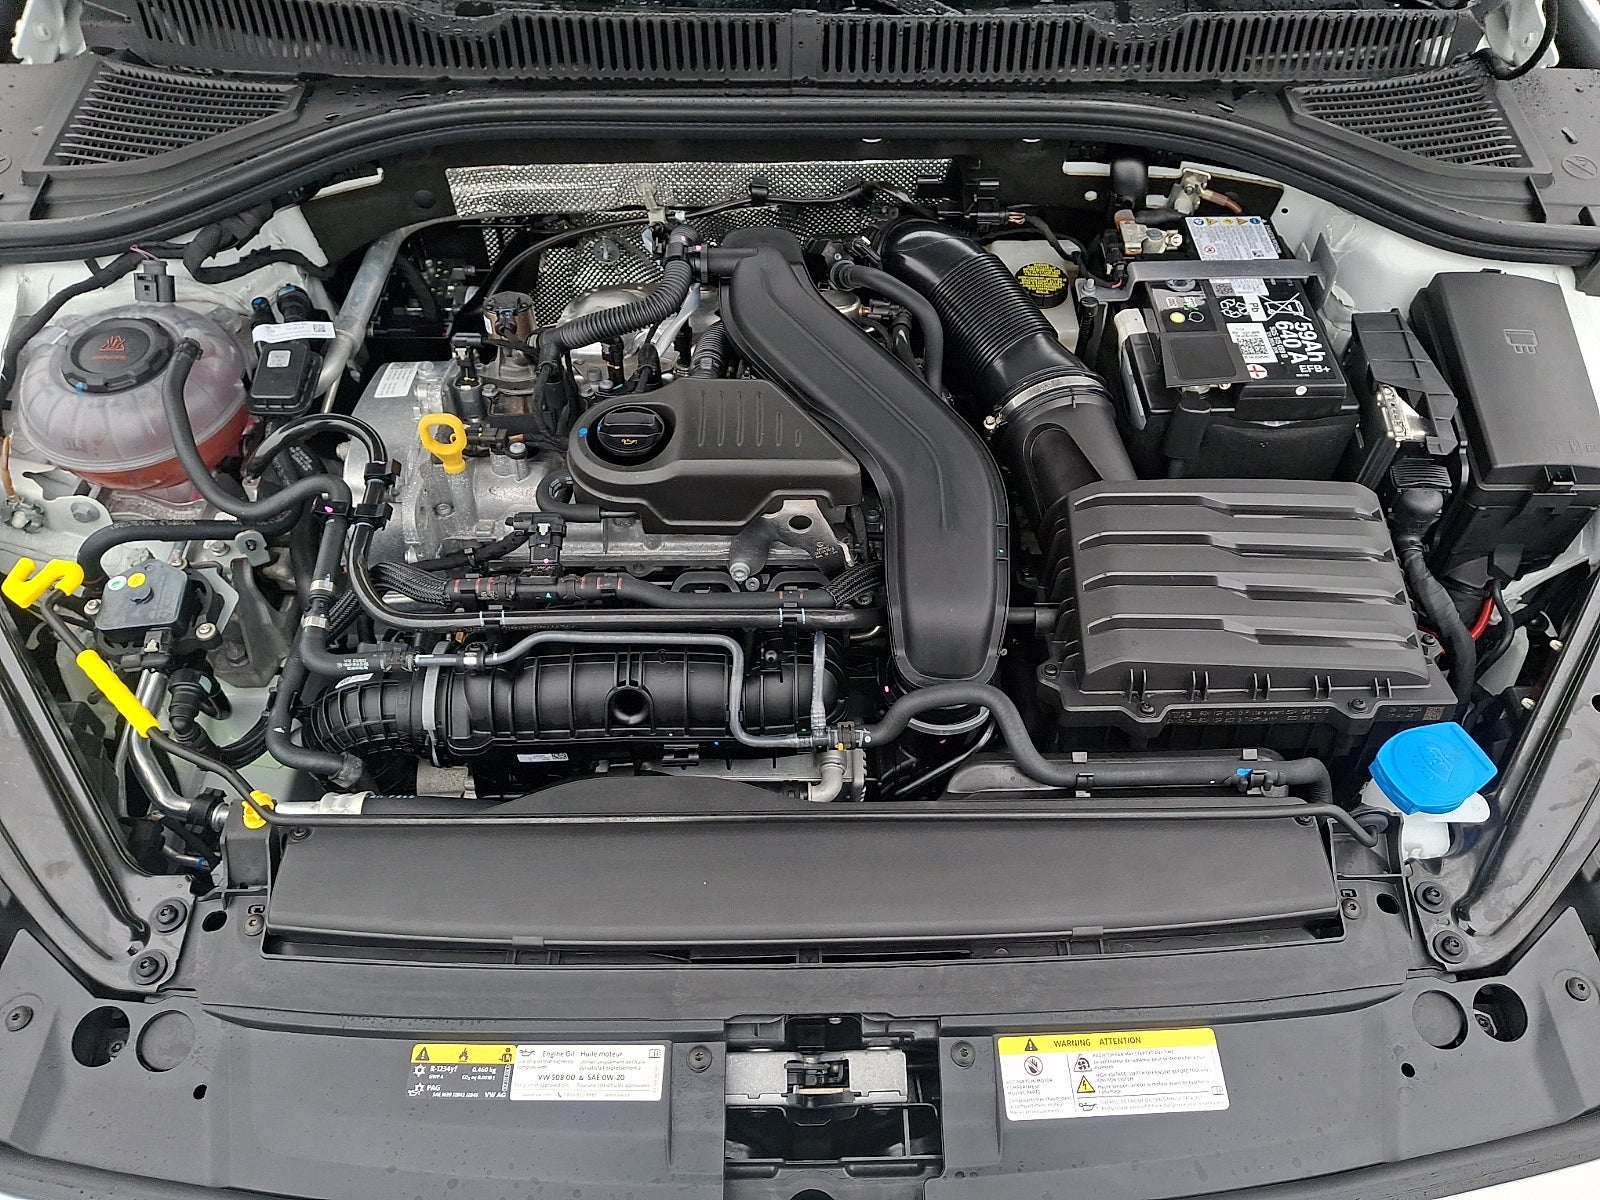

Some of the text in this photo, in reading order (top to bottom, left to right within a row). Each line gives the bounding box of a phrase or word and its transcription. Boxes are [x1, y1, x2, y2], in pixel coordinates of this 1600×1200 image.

[1250, 302, 1260, 312] Pb
[1275, 320, 1302, 348] 640
[1294, 322, 1326, 362] 59Ah
[1288, 350, 1308, 364] A
[1299, 365, 1331, 373] EFB+
[1054, 1036, 1142, 1048] WARNING ATTENTION
[430, 1065, 458, 1074] R-1234yf
